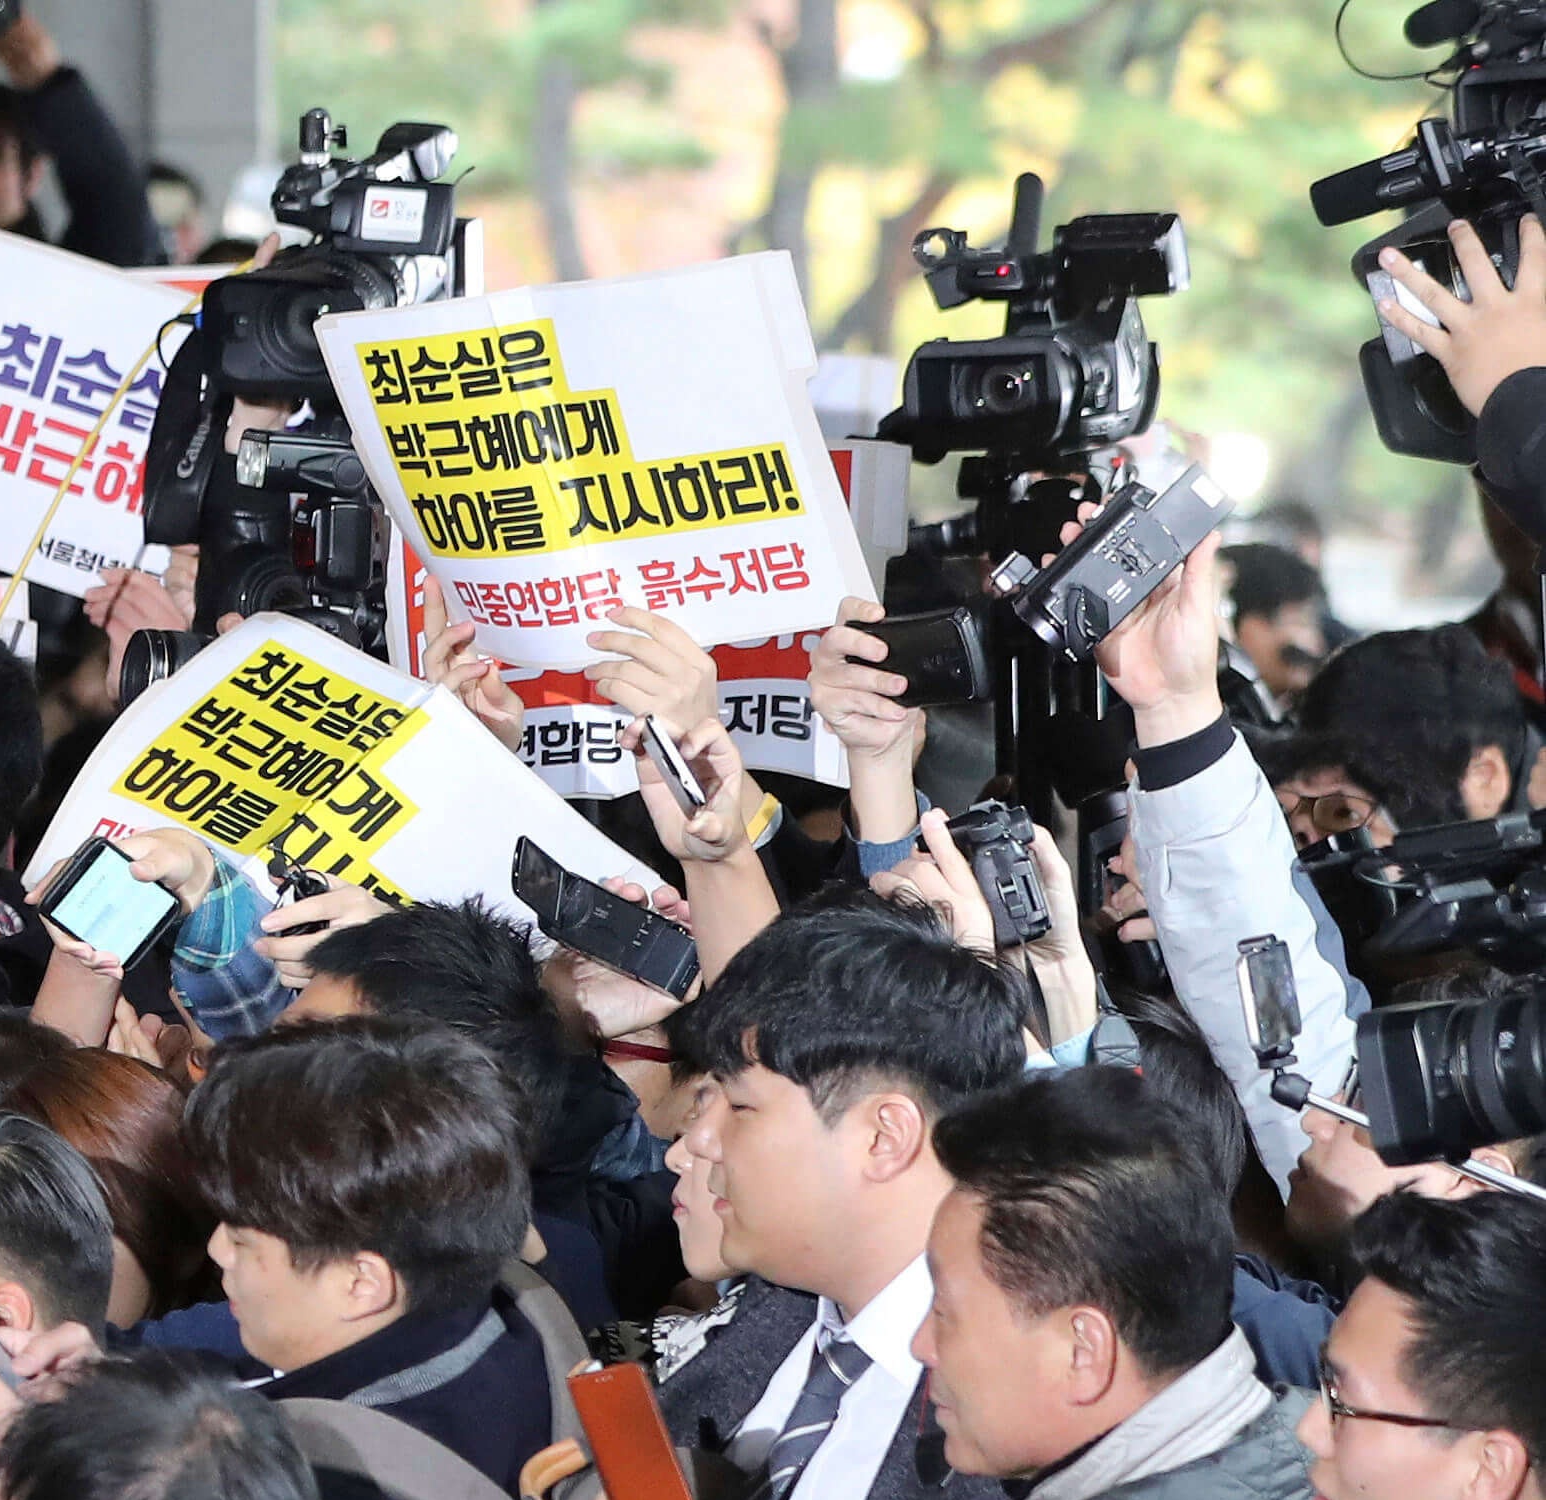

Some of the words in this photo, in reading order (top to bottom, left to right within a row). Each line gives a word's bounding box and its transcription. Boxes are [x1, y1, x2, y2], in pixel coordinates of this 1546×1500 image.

[363, 329, 554, 406] 최순실은
[384, 397, 621, 479] 박근혜에게
[412, 485, 547, 554] 하야를
[559, 448, 802, 538] 지시하라!
[452, 568, 624, 630] 민중연합당
[636, 541, 811, 611] 흙수저당
[124, 746, 279, 845] 하야를
[180, 696, 404, 842] 박근혜에게
